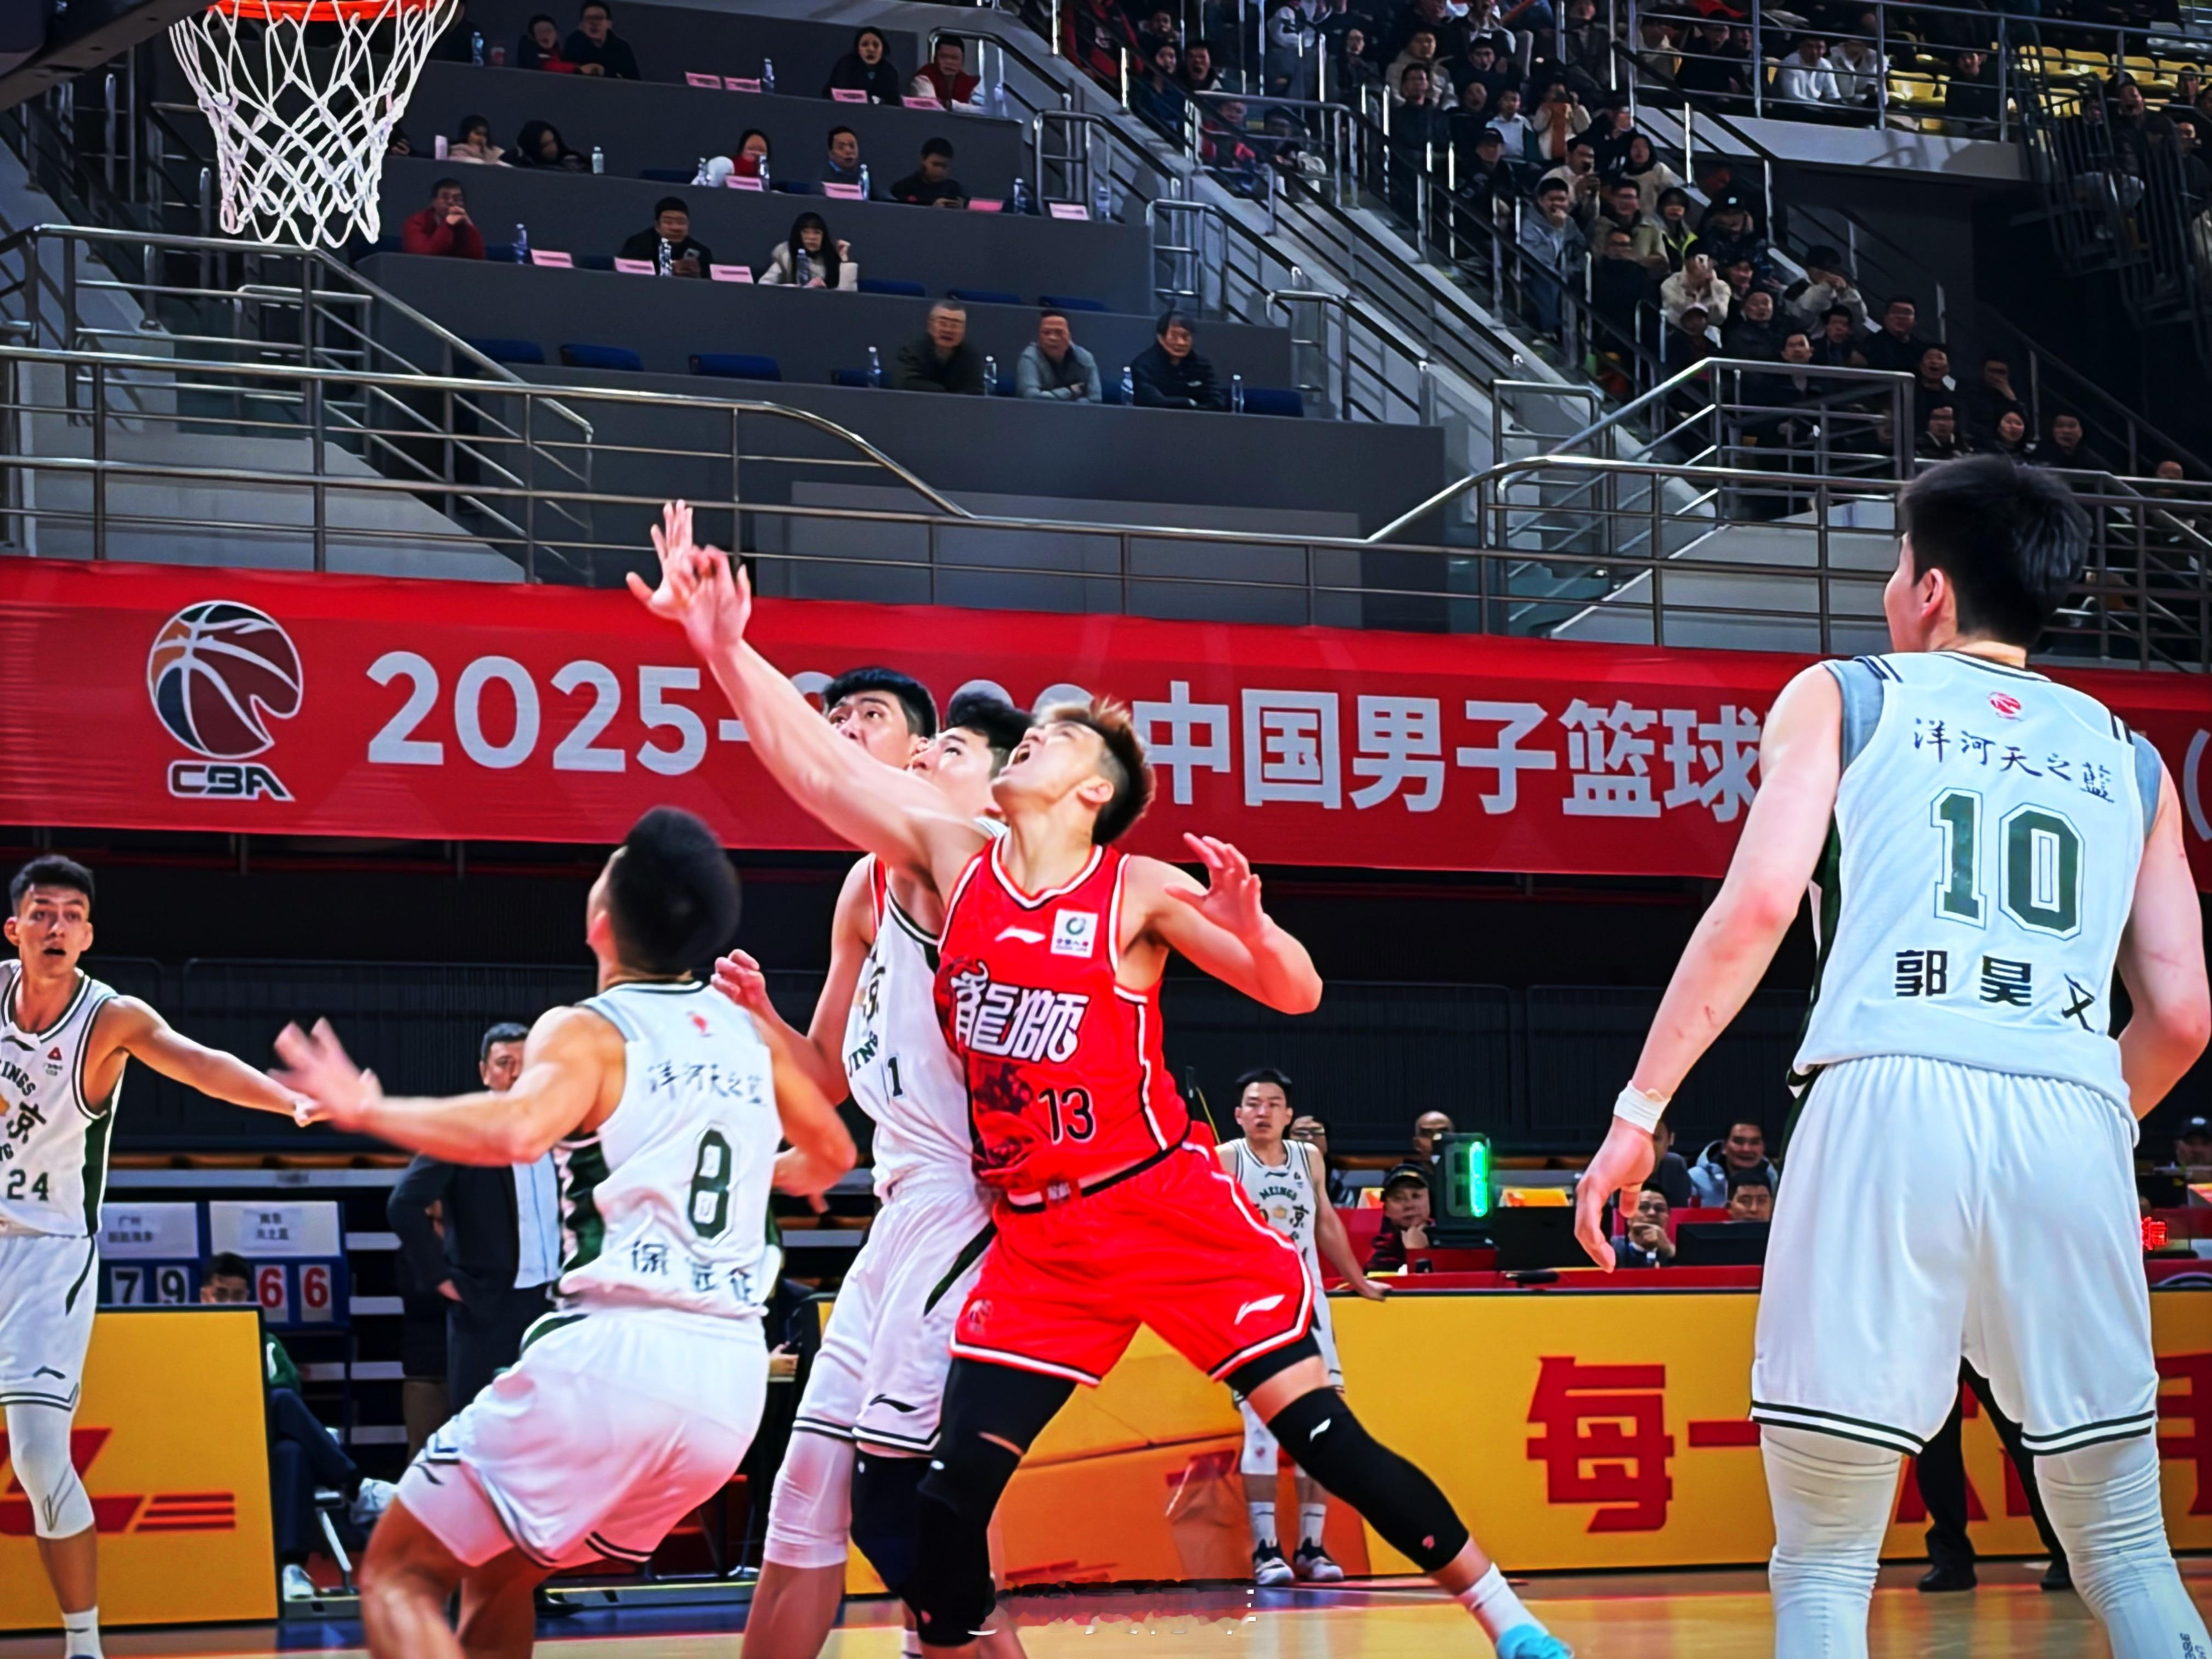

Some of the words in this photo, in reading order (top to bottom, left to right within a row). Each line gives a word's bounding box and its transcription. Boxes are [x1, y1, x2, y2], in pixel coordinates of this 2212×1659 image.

[168, 760, 295, 801] CBA
[1931, 787, 2086, 941] 10
[1894, 949, 2096, 1034] 郭昊文
[0, 1059, 37, 1097] INGS
[6, 1101, 47, 1144] 京
[1038, 1087, 1096, 1145] 13
[7, 1168, 49, 1201] 24
[687, 1127, 734, 1241] 8
[115, 1270, 185, 1304] 79
[258, 1267, 329, 1309] 66
